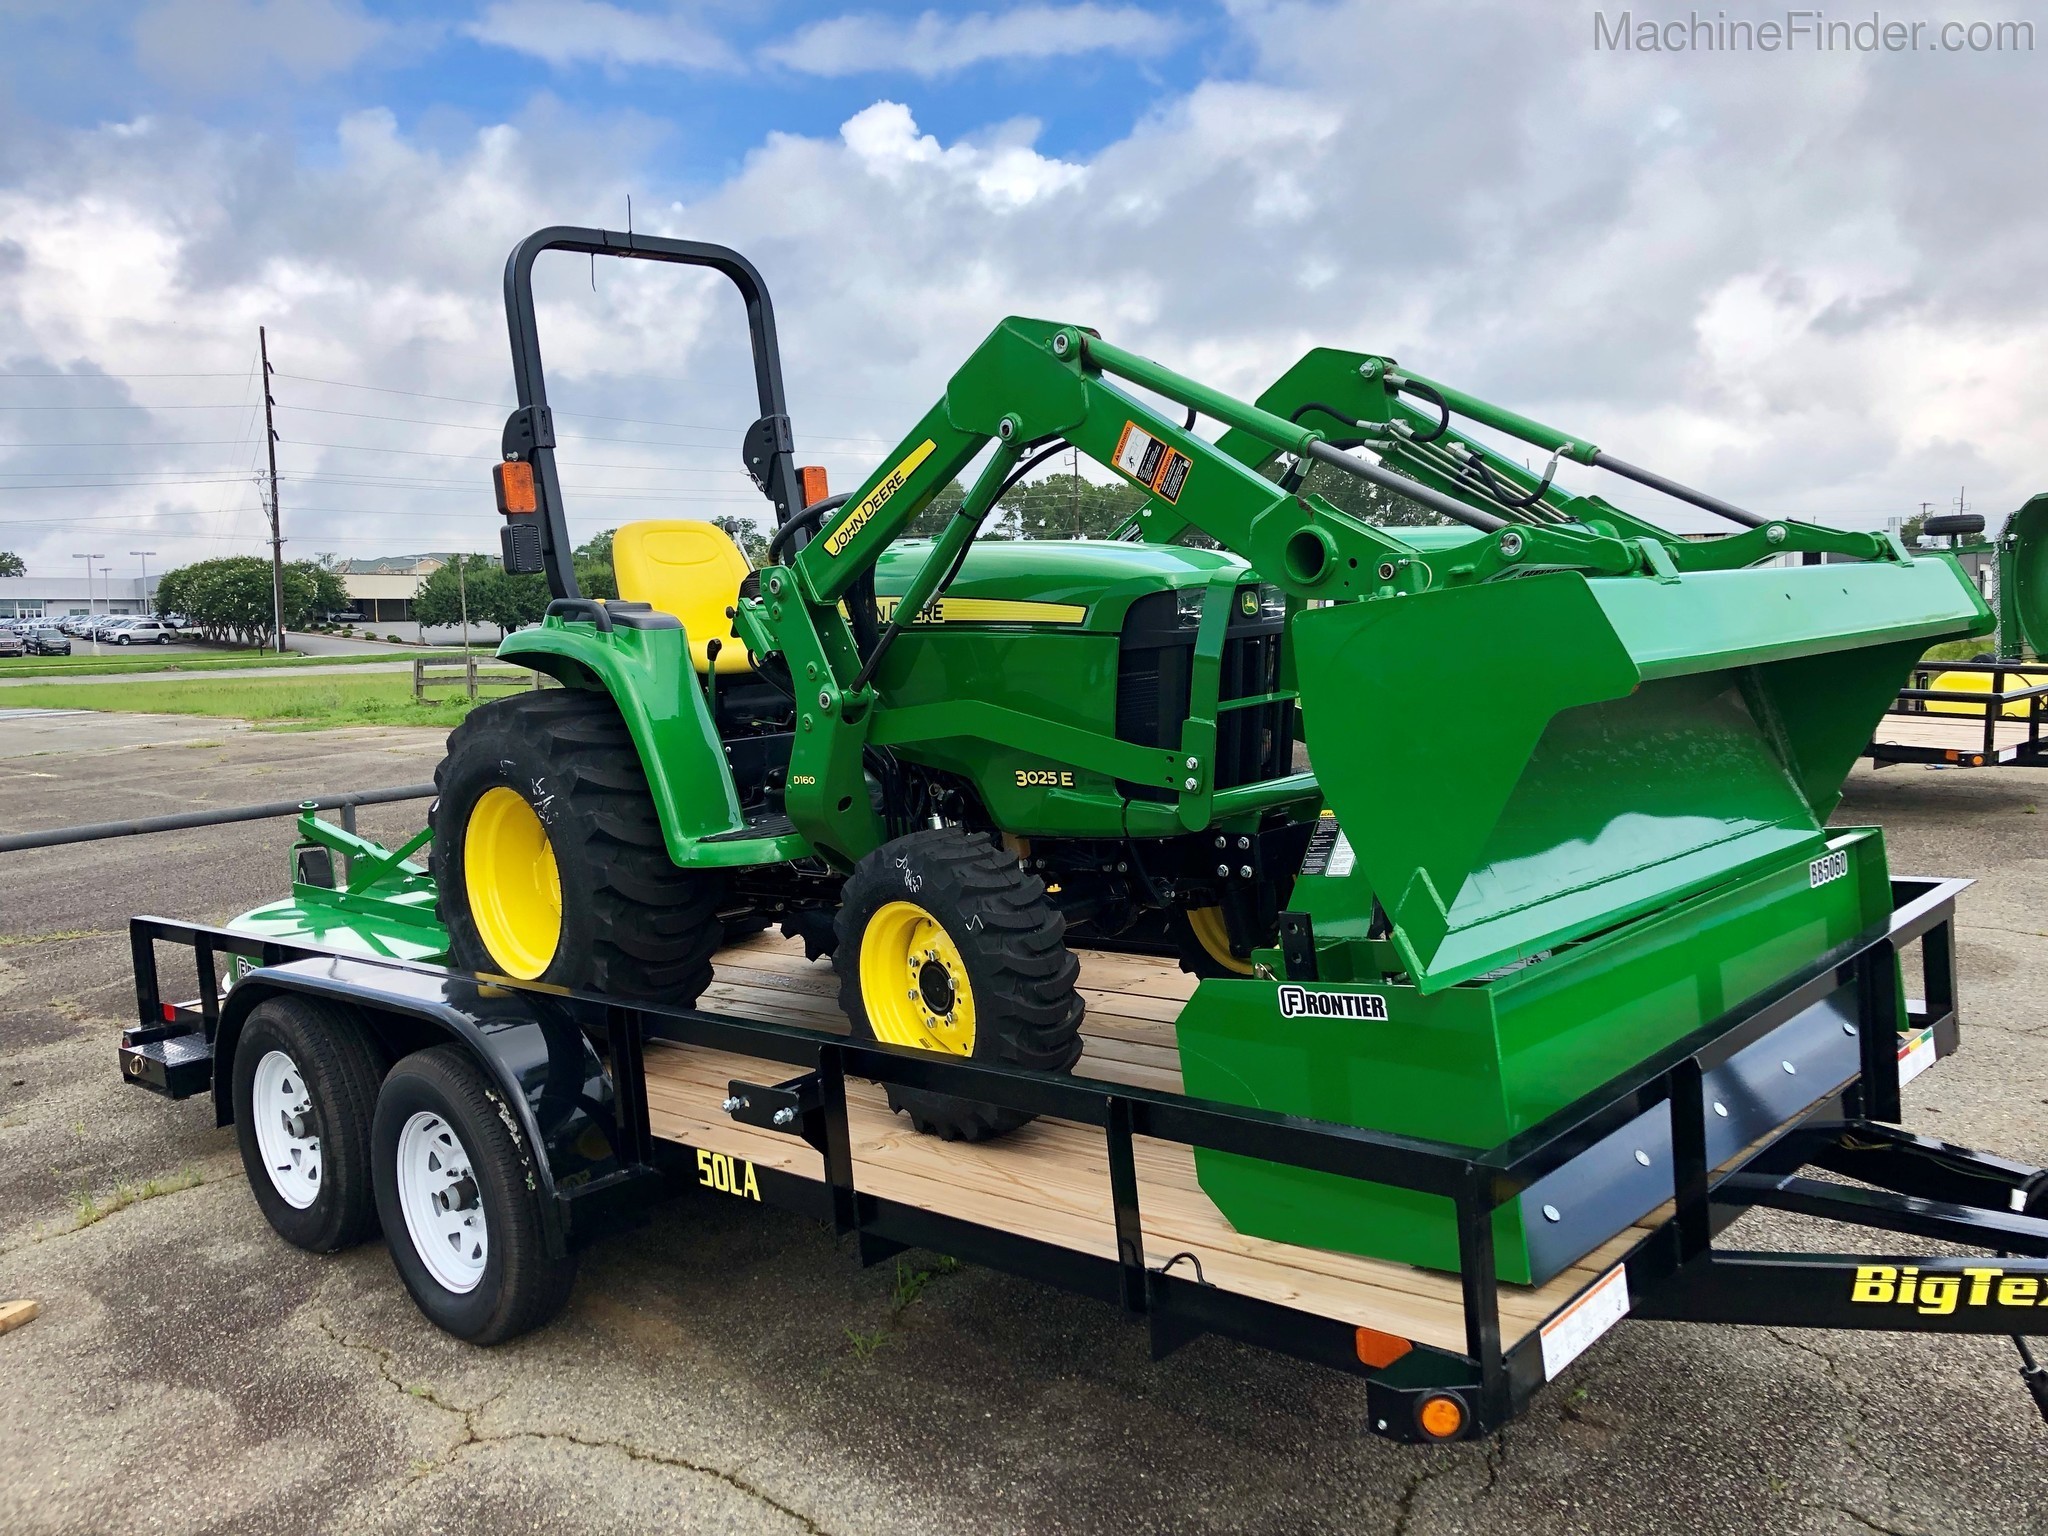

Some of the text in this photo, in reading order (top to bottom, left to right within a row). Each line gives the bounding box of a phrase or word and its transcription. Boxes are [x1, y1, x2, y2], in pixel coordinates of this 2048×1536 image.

[1117, 426, 1131, 455] WARNING
[1159, 453, 1173, 481] WARNING
[833, 470, 905, 553] JOHN DEERE
[793, 775, 816, 785] D160
[1015, 770, 1075, 787] 3025 E
[1810, 851, 1846, 886] BB5060
[1280, 986, 1386, 1018] FRONTIER
[1851, 1265, 2048, 1315] BigTe
